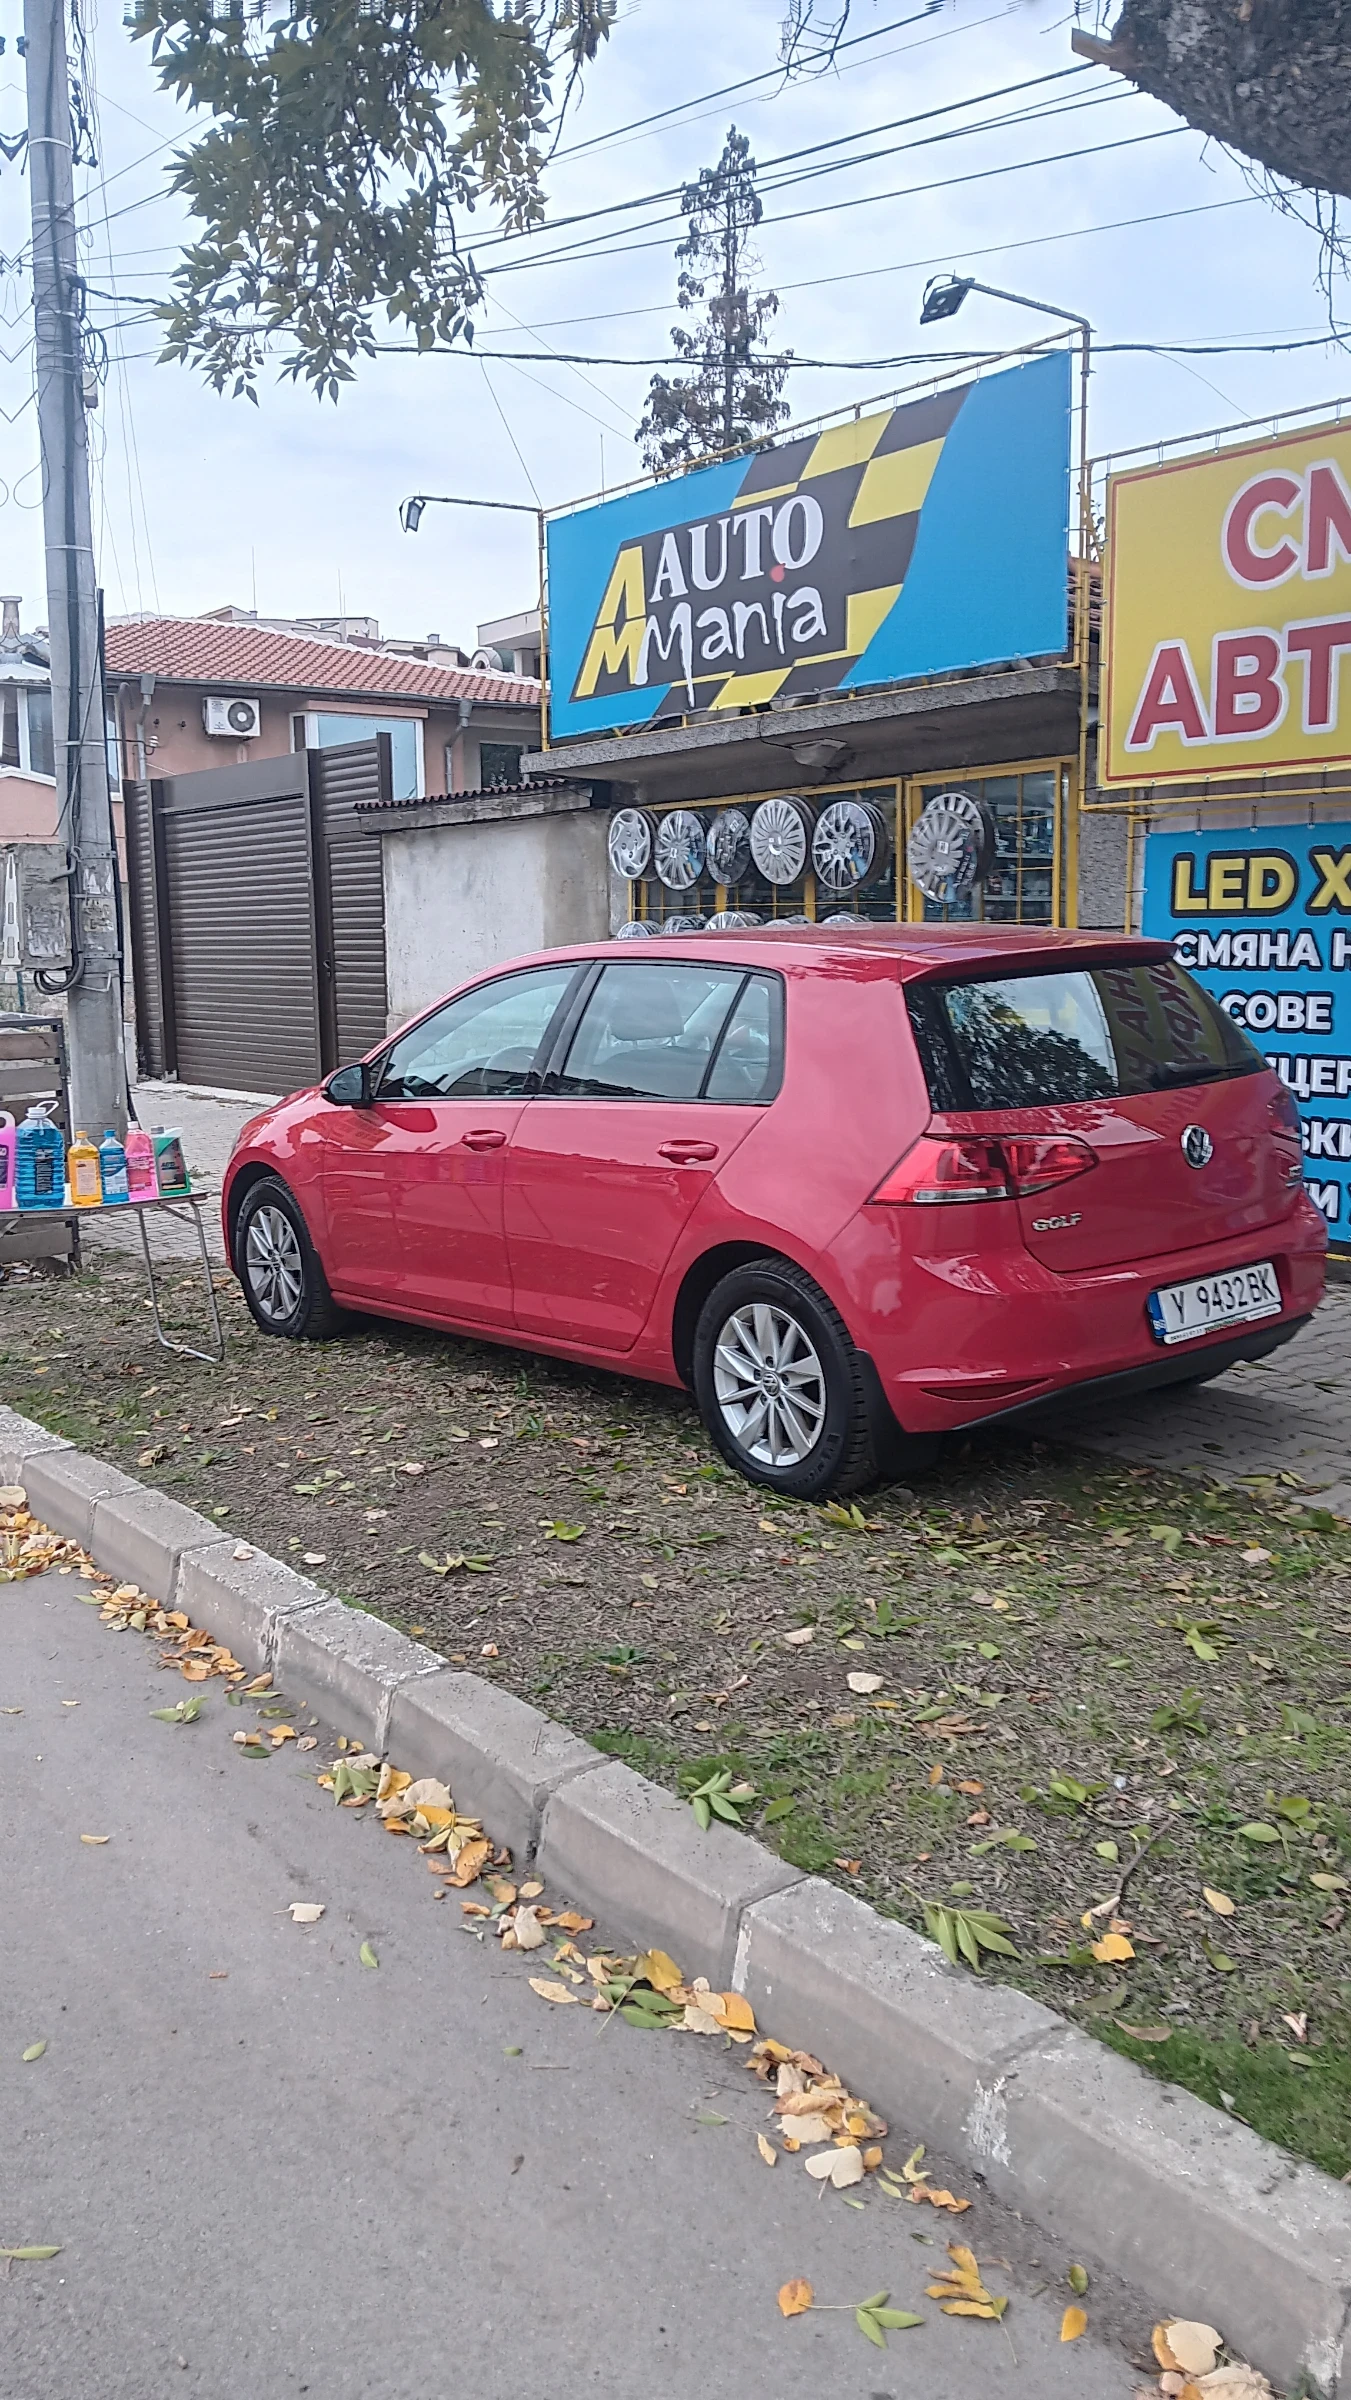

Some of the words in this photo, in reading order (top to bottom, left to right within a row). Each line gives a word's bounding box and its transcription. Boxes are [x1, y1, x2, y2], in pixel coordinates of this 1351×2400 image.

[649, 494, 824, 603] AUTO
[635, 586, 827, 707] Mania
[1129, 620, 1351, 745] АВТ
[1174, 856, 1296, 911] LED
[1172, 932, 1322, 967] СМЯНА
[1218, 993, 1333, 1030] СОВЕ
[1266, 1056, 1351, 1099] ЦЕР
[1032, 1212, 1082, 1231] GOLF
